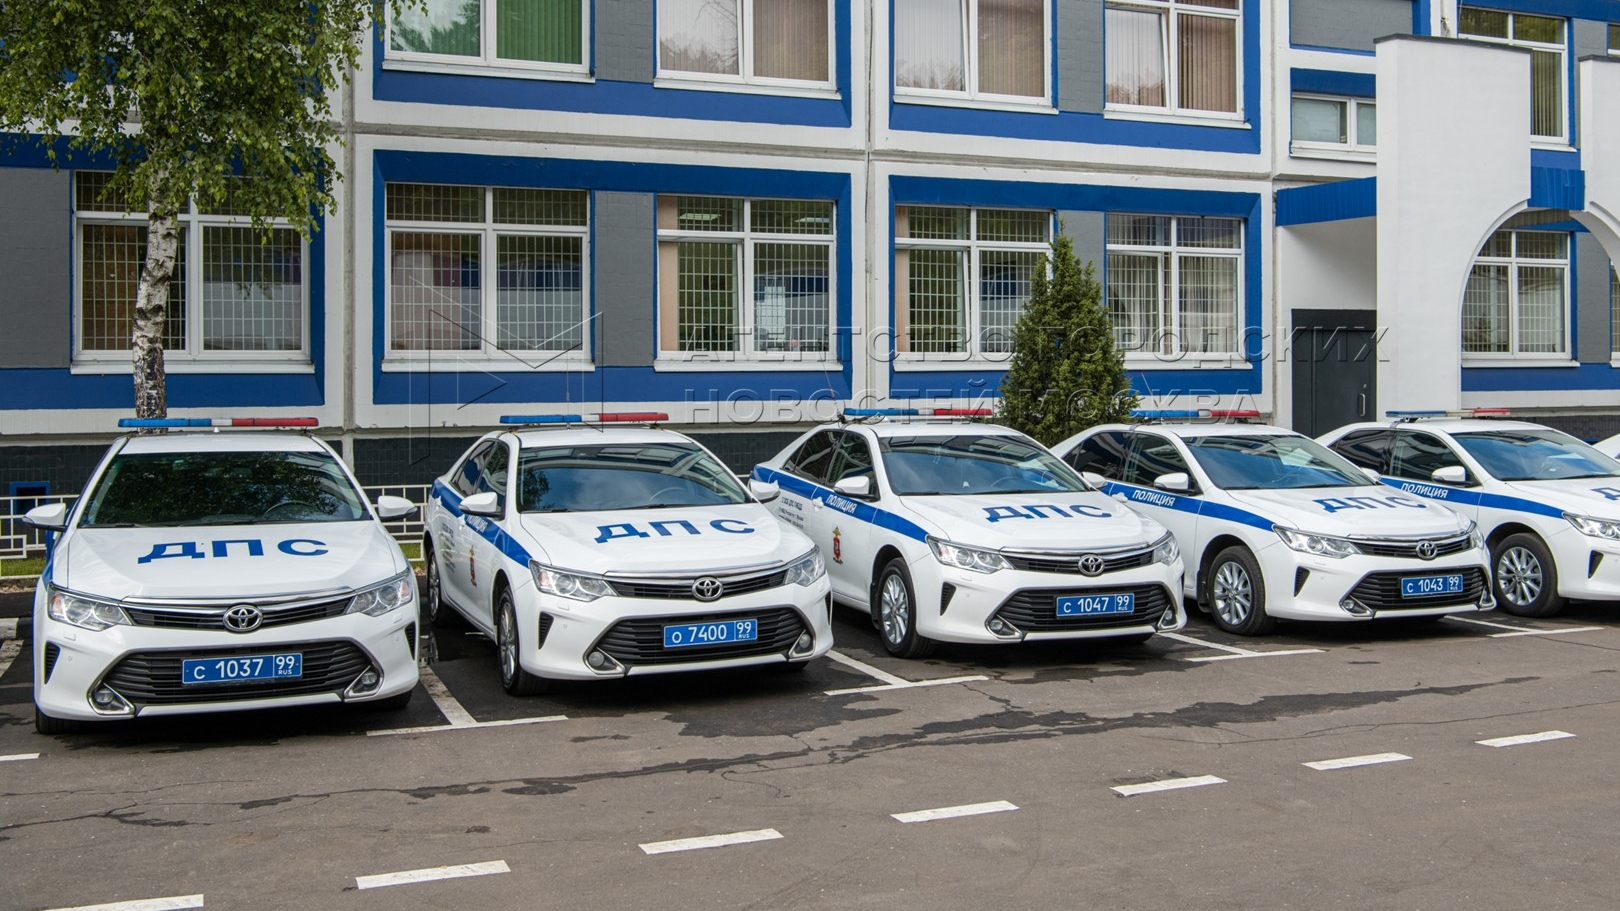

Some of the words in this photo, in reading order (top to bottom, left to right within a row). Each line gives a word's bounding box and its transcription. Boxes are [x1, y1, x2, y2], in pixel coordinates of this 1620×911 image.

[1132, 489, 1176, 507] ПОЛИЦИЯ
[1401, 483, 1449, 499] ПОЛИЦИЯ
[825, 494, 858, 514] ПОЛИЦИЯ
[982, 504, 1112, 523] ДПС
[1312, 496, 1427, 513] ДПС
[594, 518, 755, 544] ДПС
[137, 538, 329, 564] ДПС
[1418, 578, 1443, 592] 1043
[1448, 576, 1459, 587] 99
[1077, 597, 1109, 613] 1047
[1116, 595, 1130, 607] 99
[688, 624, 727, 643] 7400
[736, 621, 752, 634] 99
[215, 658, 264, 678] 1037
[276, 655, 295, 670] 99
